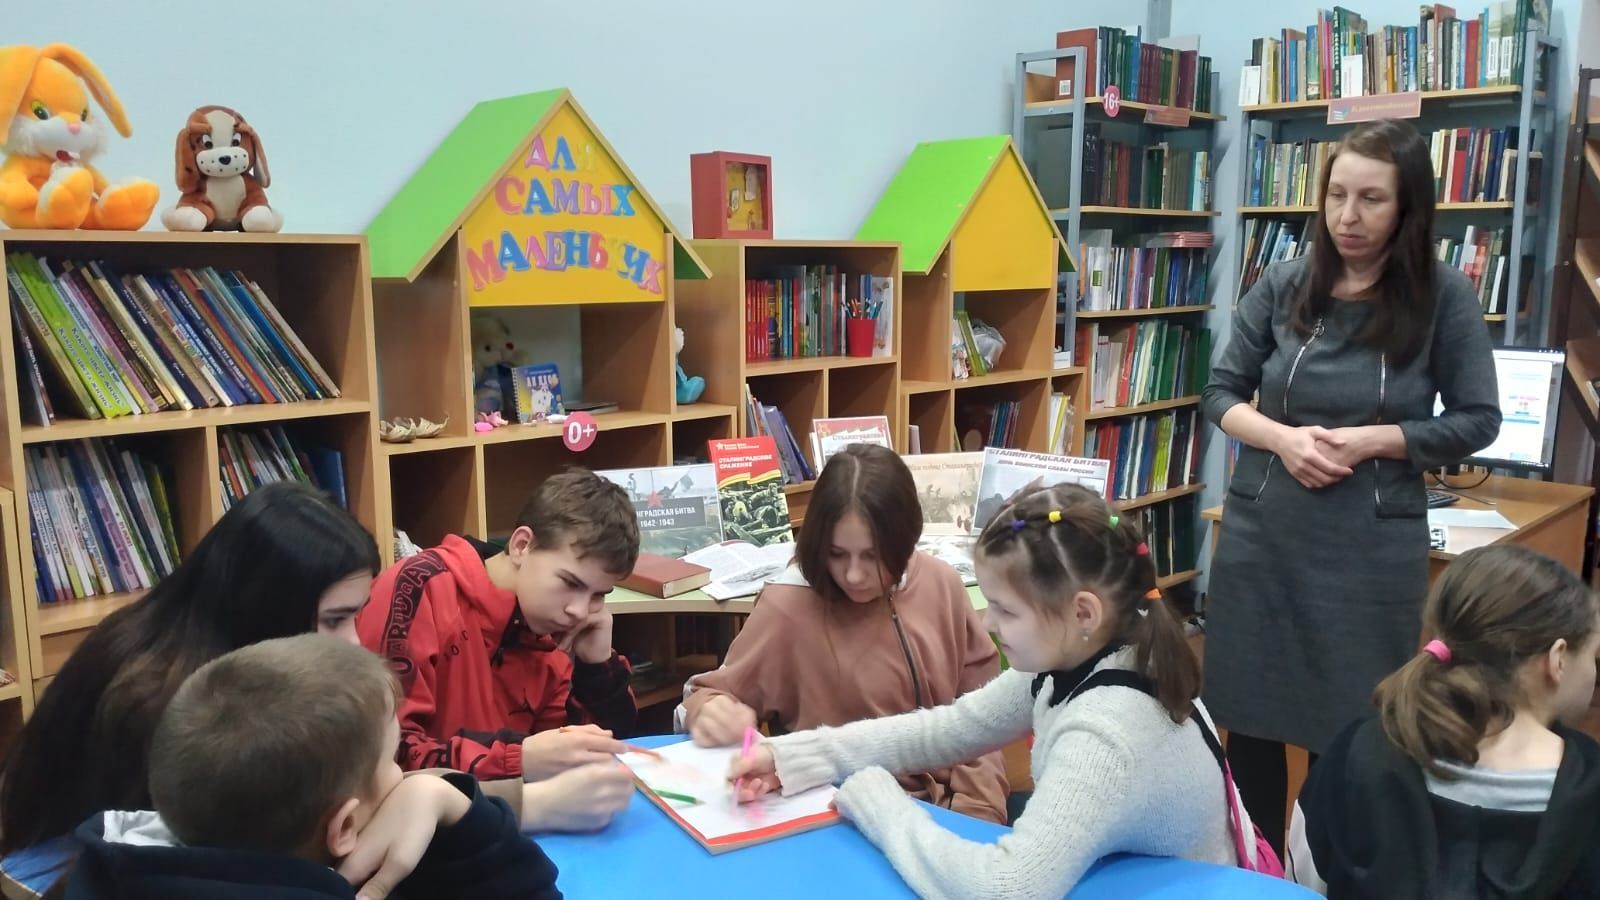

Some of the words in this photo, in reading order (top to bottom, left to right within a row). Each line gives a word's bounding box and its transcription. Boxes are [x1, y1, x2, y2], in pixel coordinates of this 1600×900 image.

[1104, 92, 1119, 110] 16+
[495, 175, 635, 217] САМЫХ
[569, 421, 594, 444] 0+
[988, 448, 1071, 463] СТАЛИНГРАДСКАЯ
[720, 461, 752, 469] СРАЖЕНИЕ
[636, 508, 674, 517] НГРАДСКАЯ
[675, 507, 696, 515] БИТВА
